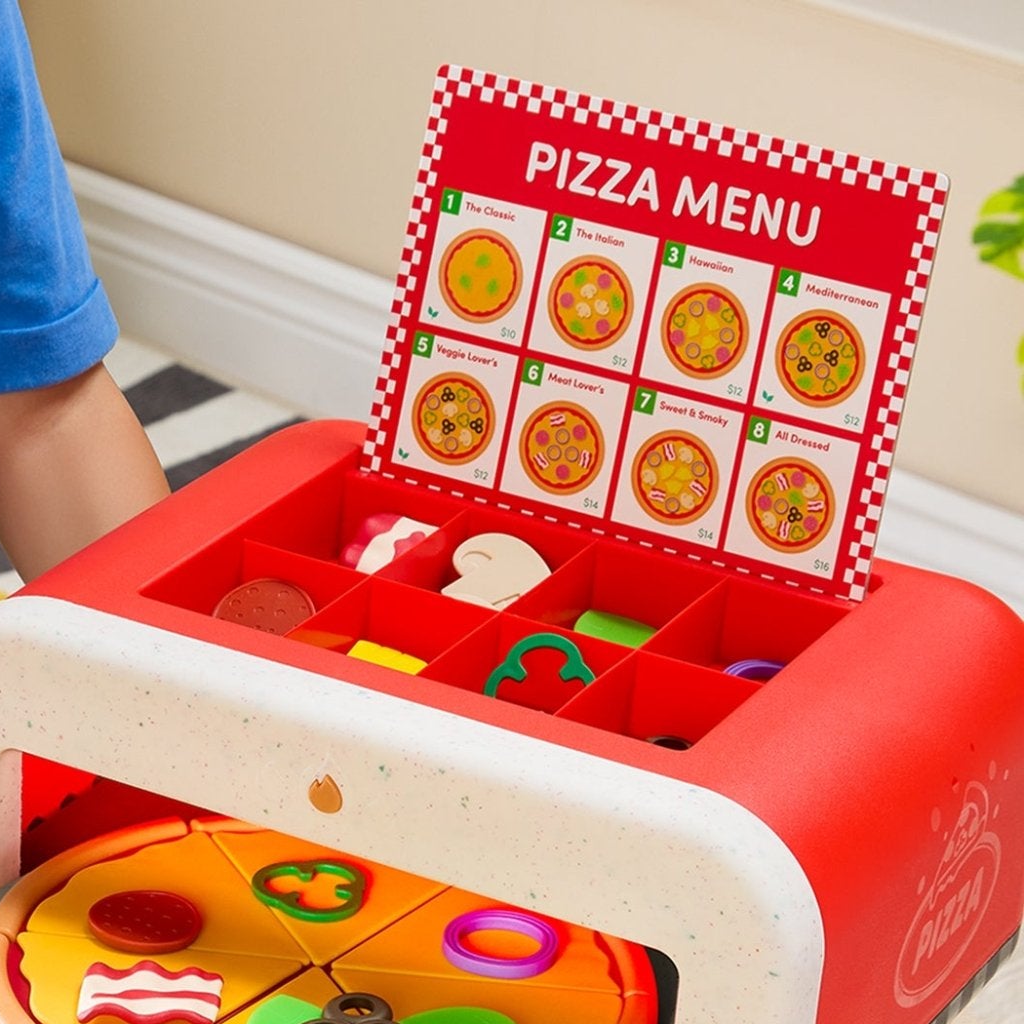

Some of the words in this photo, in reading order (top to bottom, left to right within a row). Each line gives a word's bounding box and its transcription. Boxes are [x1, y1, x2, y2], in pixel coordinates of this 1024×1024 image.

[446, 194, 456, 210] 1
[525, 141, 660, 212] PIZZA
[672, 175, 821, 247] MENU
[465, 202, 482, 214] The
[484, 206, 516, 221] Classic
[556, 220, 568, 237] 2
[576, 228, 594, 240] The
[595, 231, 625, 248] Italian
[668, 247, 679, 262] 3
[689, 255, 734, 274] Hawaiian
[783, 275, 794, 291] 4
[805, 284, 879, 309] Mediterranean
[500, 327, 516, 340] $10
[417, 337, 428, 352] 5
[437, 344, 466, 360] Veggie
[612, 356, 628, 368] $12
[528, 365, 538, 381] 6
[548, 373, 572, 386] Meat
[727, 384, 743, 396] $12
[640, 392, 651, 409] 7
[660, 401, 687, 416] Sweet
[689, 408, 697, 418] &
[698, 411, 728, 428] Smoky
[844, 413, 860, 426] $12
[753, 422, 764, 439] 8
[775, 430, 789, 442] All
[790, 434, 830, 451] Dressed
[474, 469, 489, 481] $12
[583, 498, 599, 510] $14
[698, 528, 714, 541] $14
[814, 559, 830, 572] $16
[911, 866, 985, 976] PIZZA
